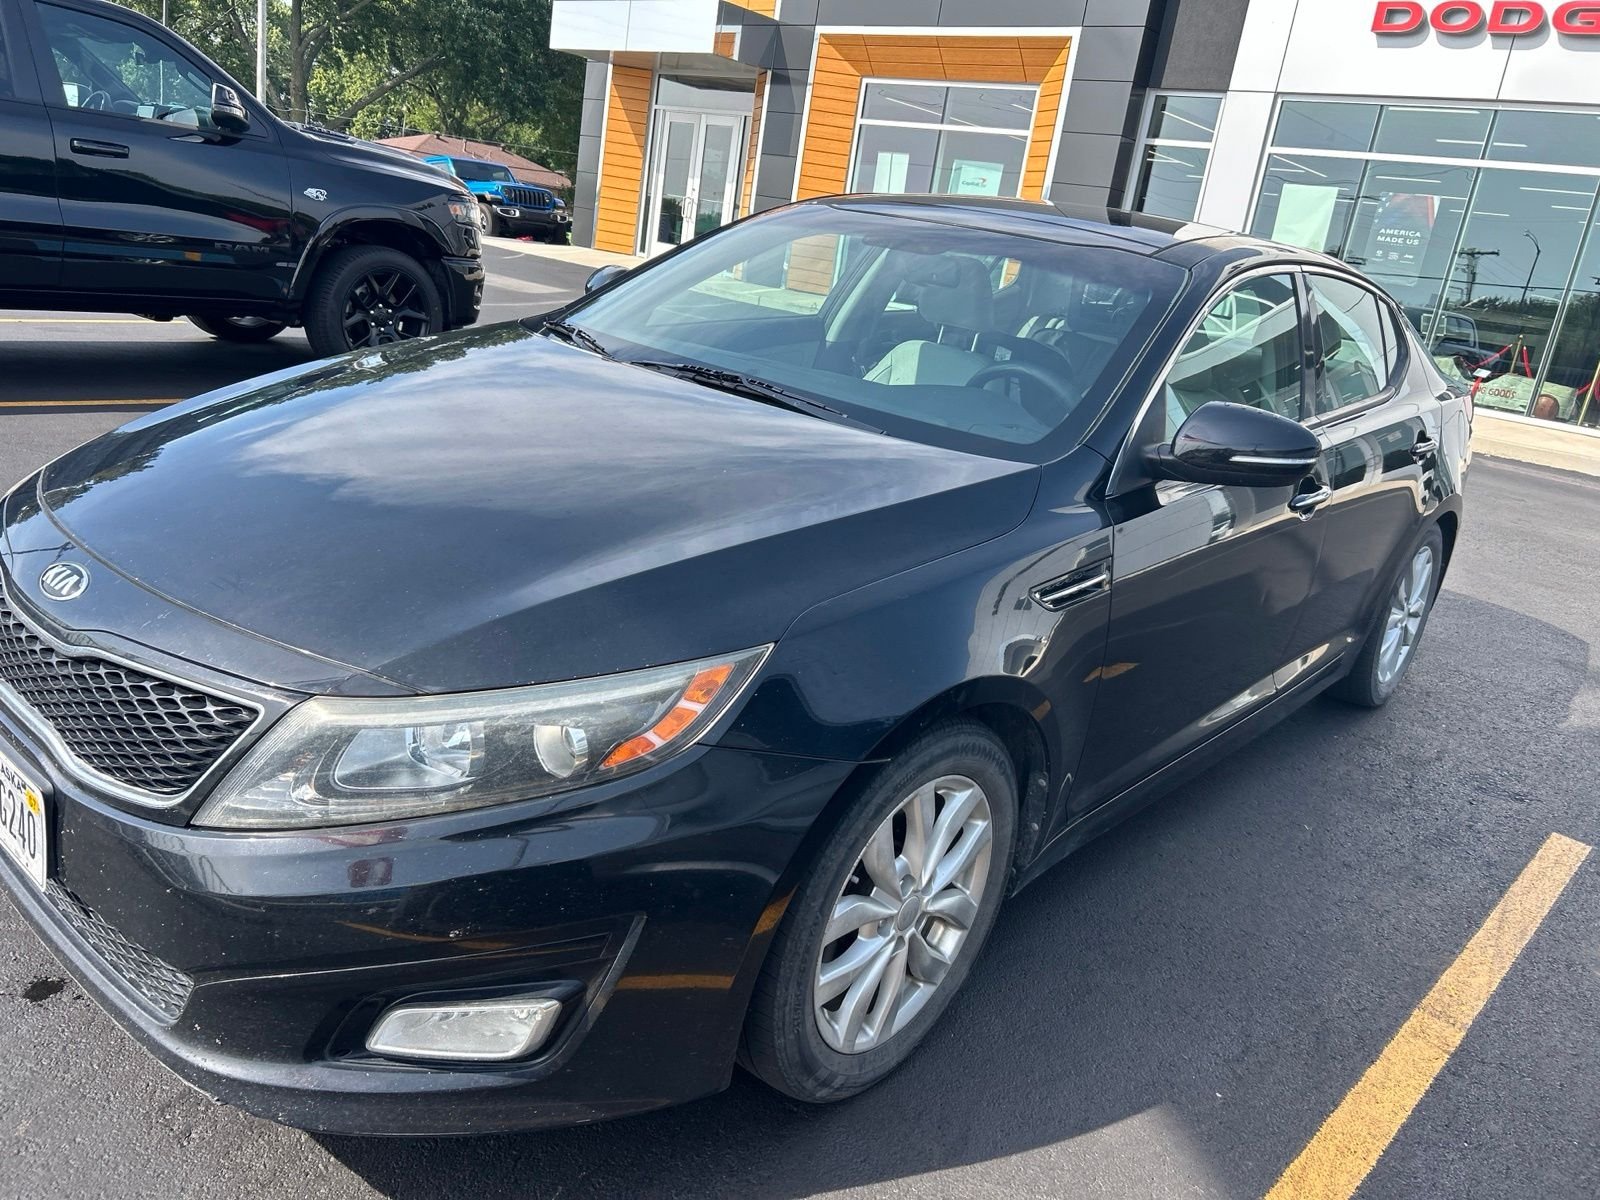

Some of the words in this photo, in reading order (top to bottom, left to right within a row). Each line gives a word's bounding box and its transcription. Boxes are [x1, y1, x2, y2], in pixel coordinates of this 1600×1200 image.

[1371, 0, 1600, 34] DODG
[215, 241, 270, 254] RAM
[1379, 228, 1421, 237] AMERICA
[1488, 388, 1516, 399] GOODS
[42, 564, 80, 595] KIA
[960, 742, 1007, 776] KUMHO
[0, 763, 23, 794] ASKA
[0, 779, 36, 860] G240
